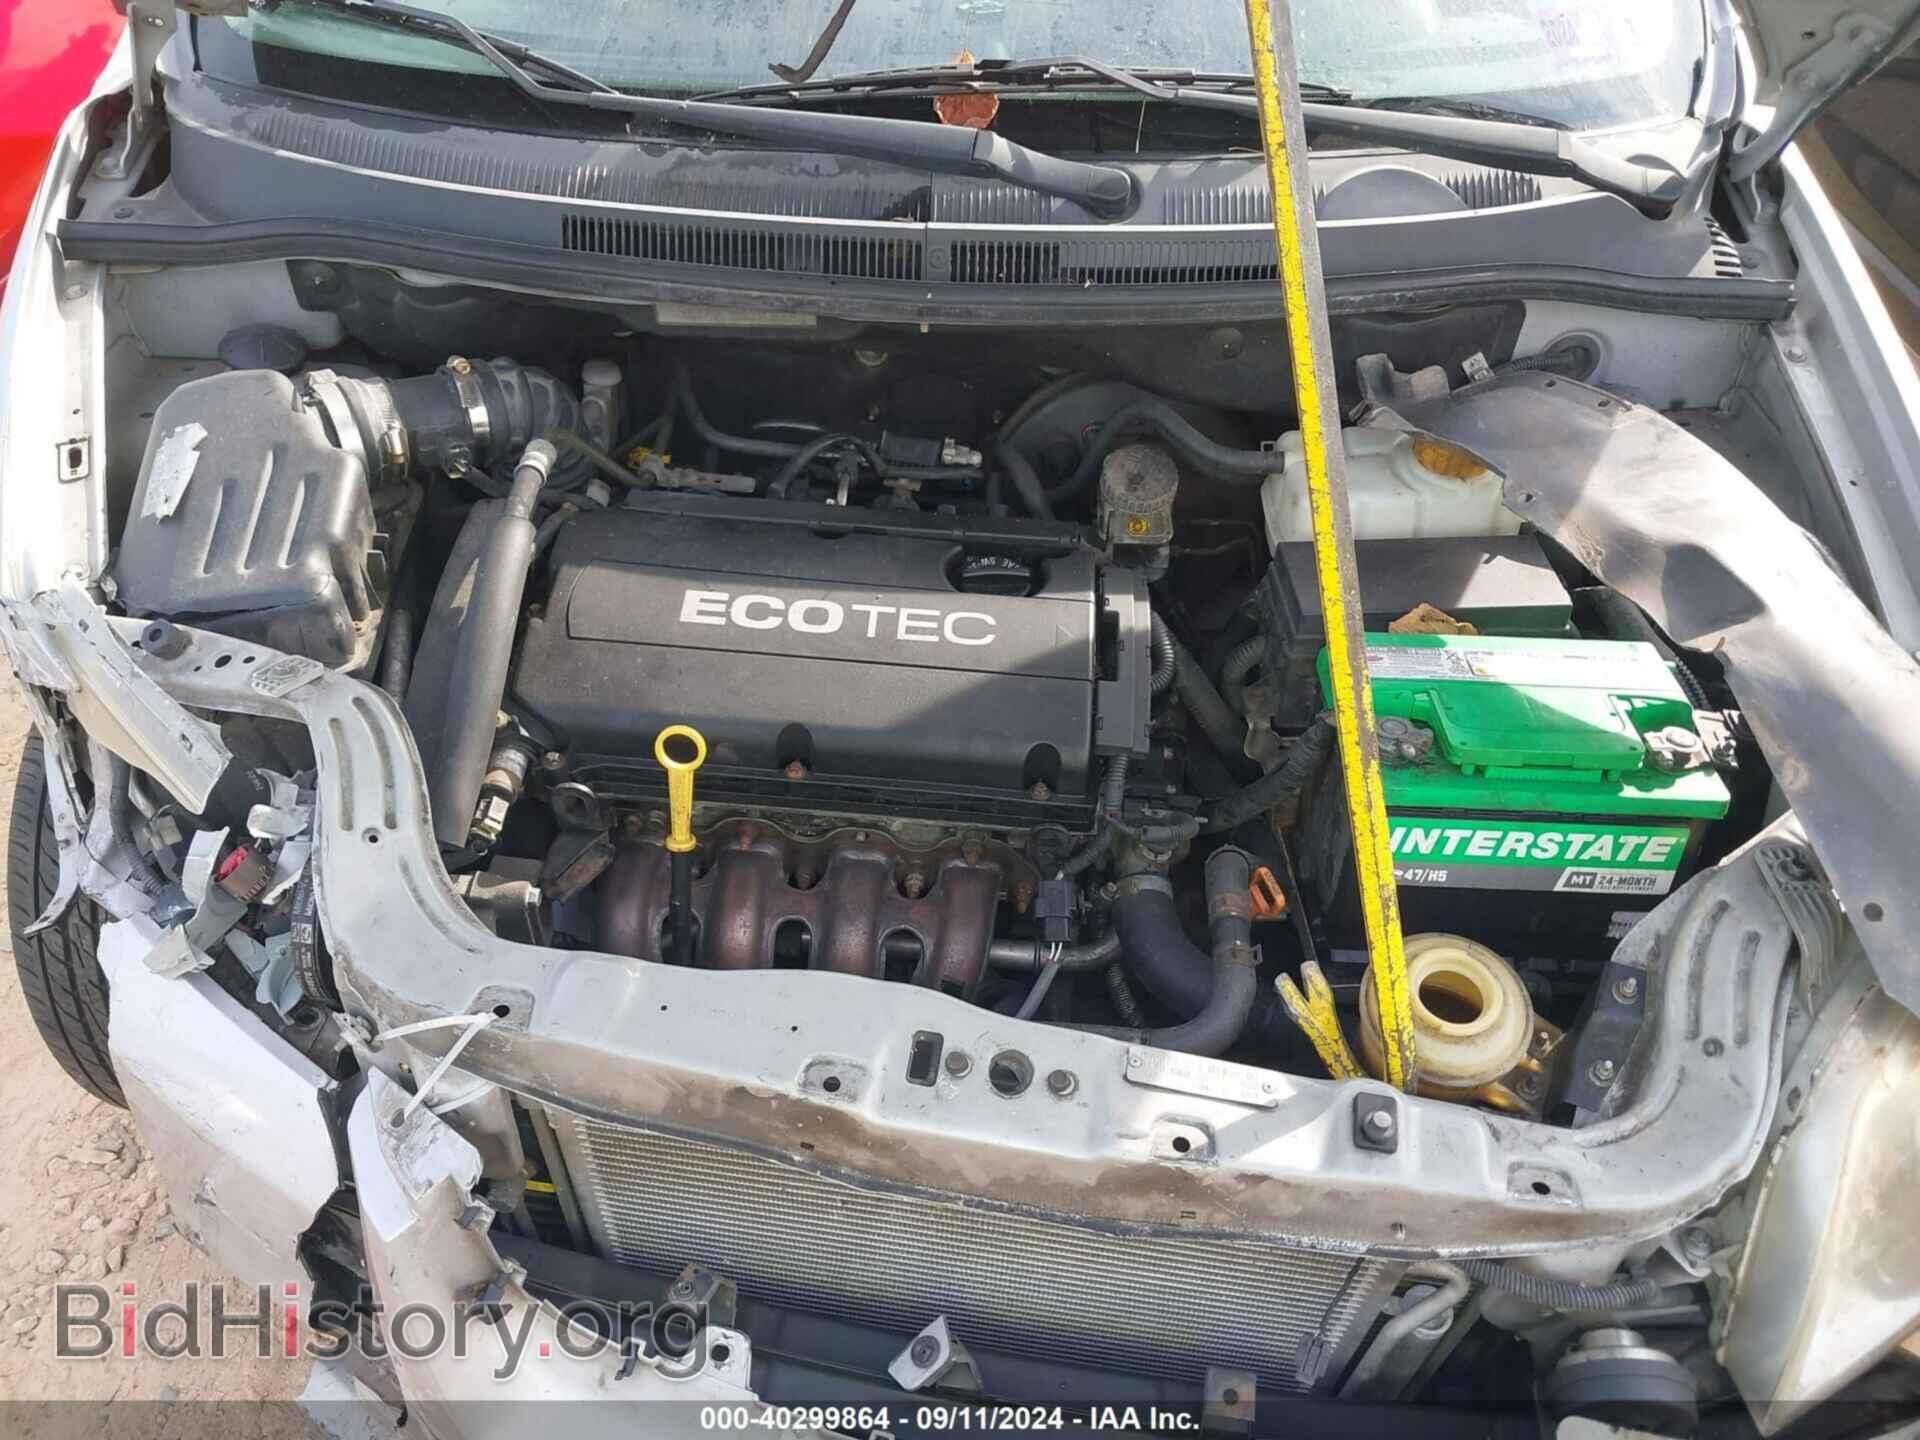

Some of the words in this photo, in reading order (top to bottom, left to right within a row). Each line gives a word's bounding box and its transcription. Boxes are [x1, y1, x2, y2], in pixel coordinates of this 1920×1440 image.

[679, 589, 997, 646] ECOTEC
[1391, 826, 1675, 862] INTERSTATE
[1403, 868, 1449, 883] 47/H5
[1570, 874, 1594, 885] MT
[1597, 875, 1657, 887] 24-MONTH
